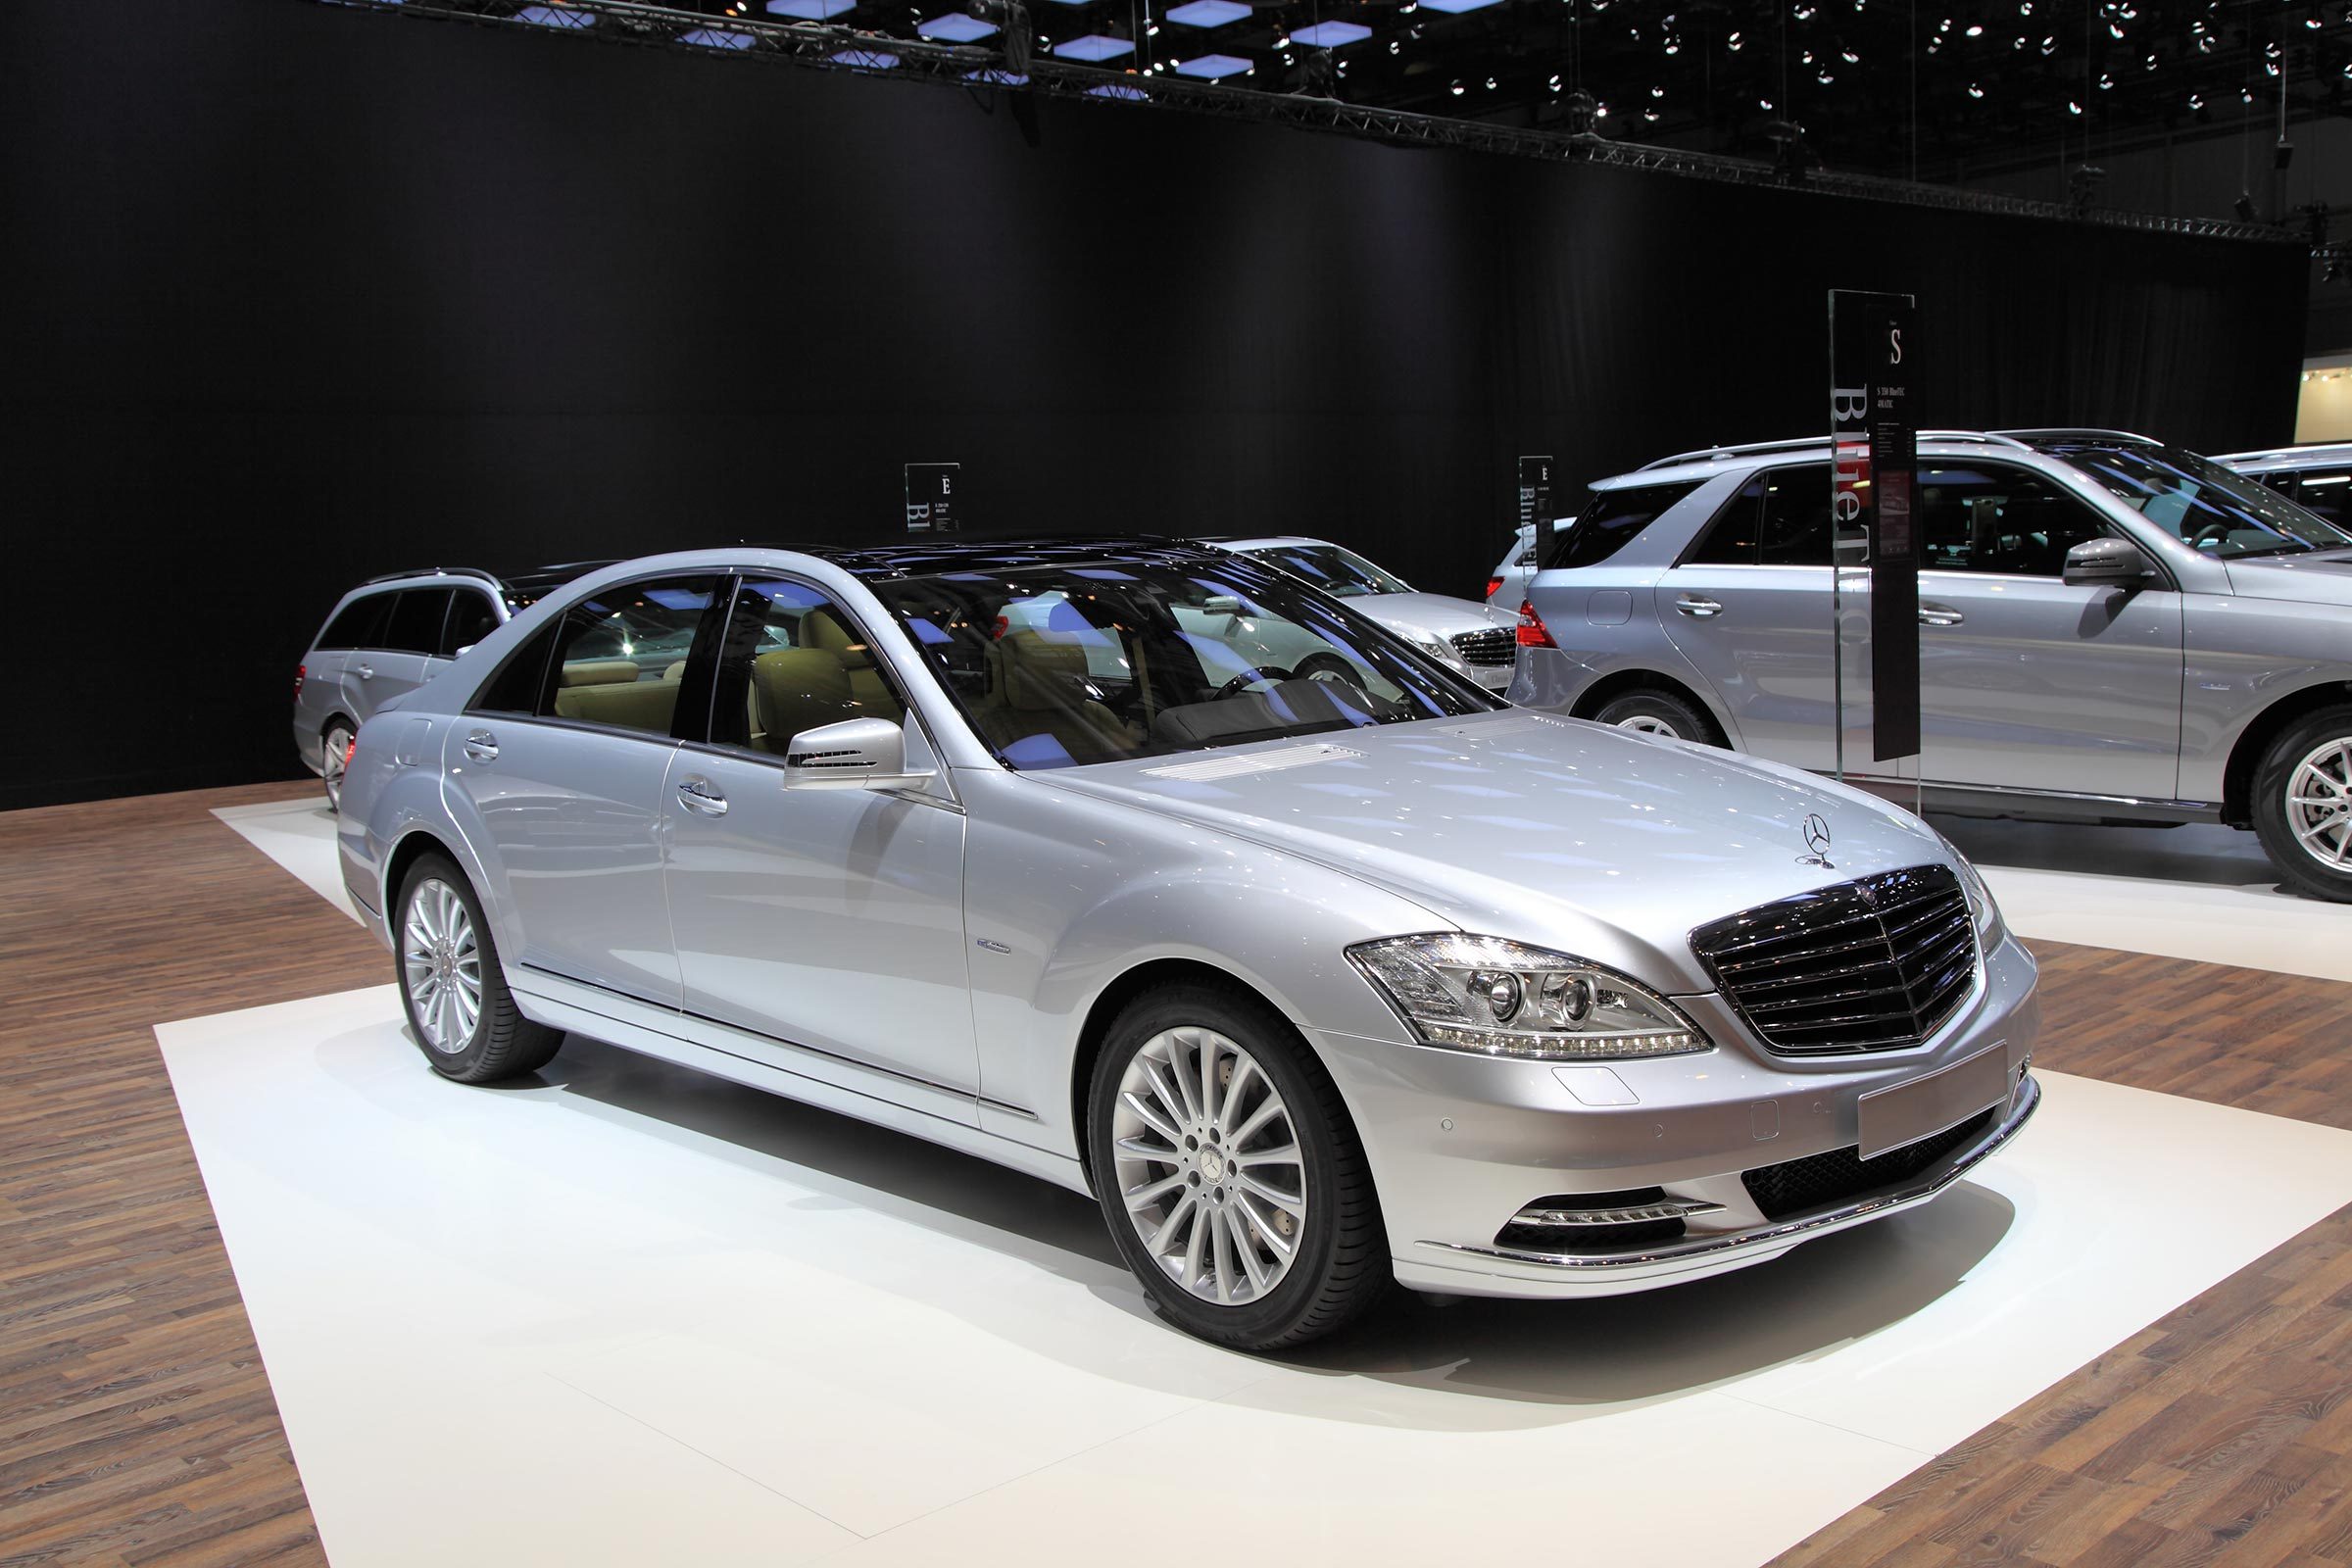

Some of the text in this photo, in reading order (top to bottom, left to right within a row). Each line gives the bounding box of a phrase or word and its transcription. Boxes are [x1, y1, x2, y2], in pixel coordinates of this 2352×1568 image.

[1890, 328, 1902, 365] S
[1543, 467, 1548, 480] E
[942, 478, 951, 495] E
